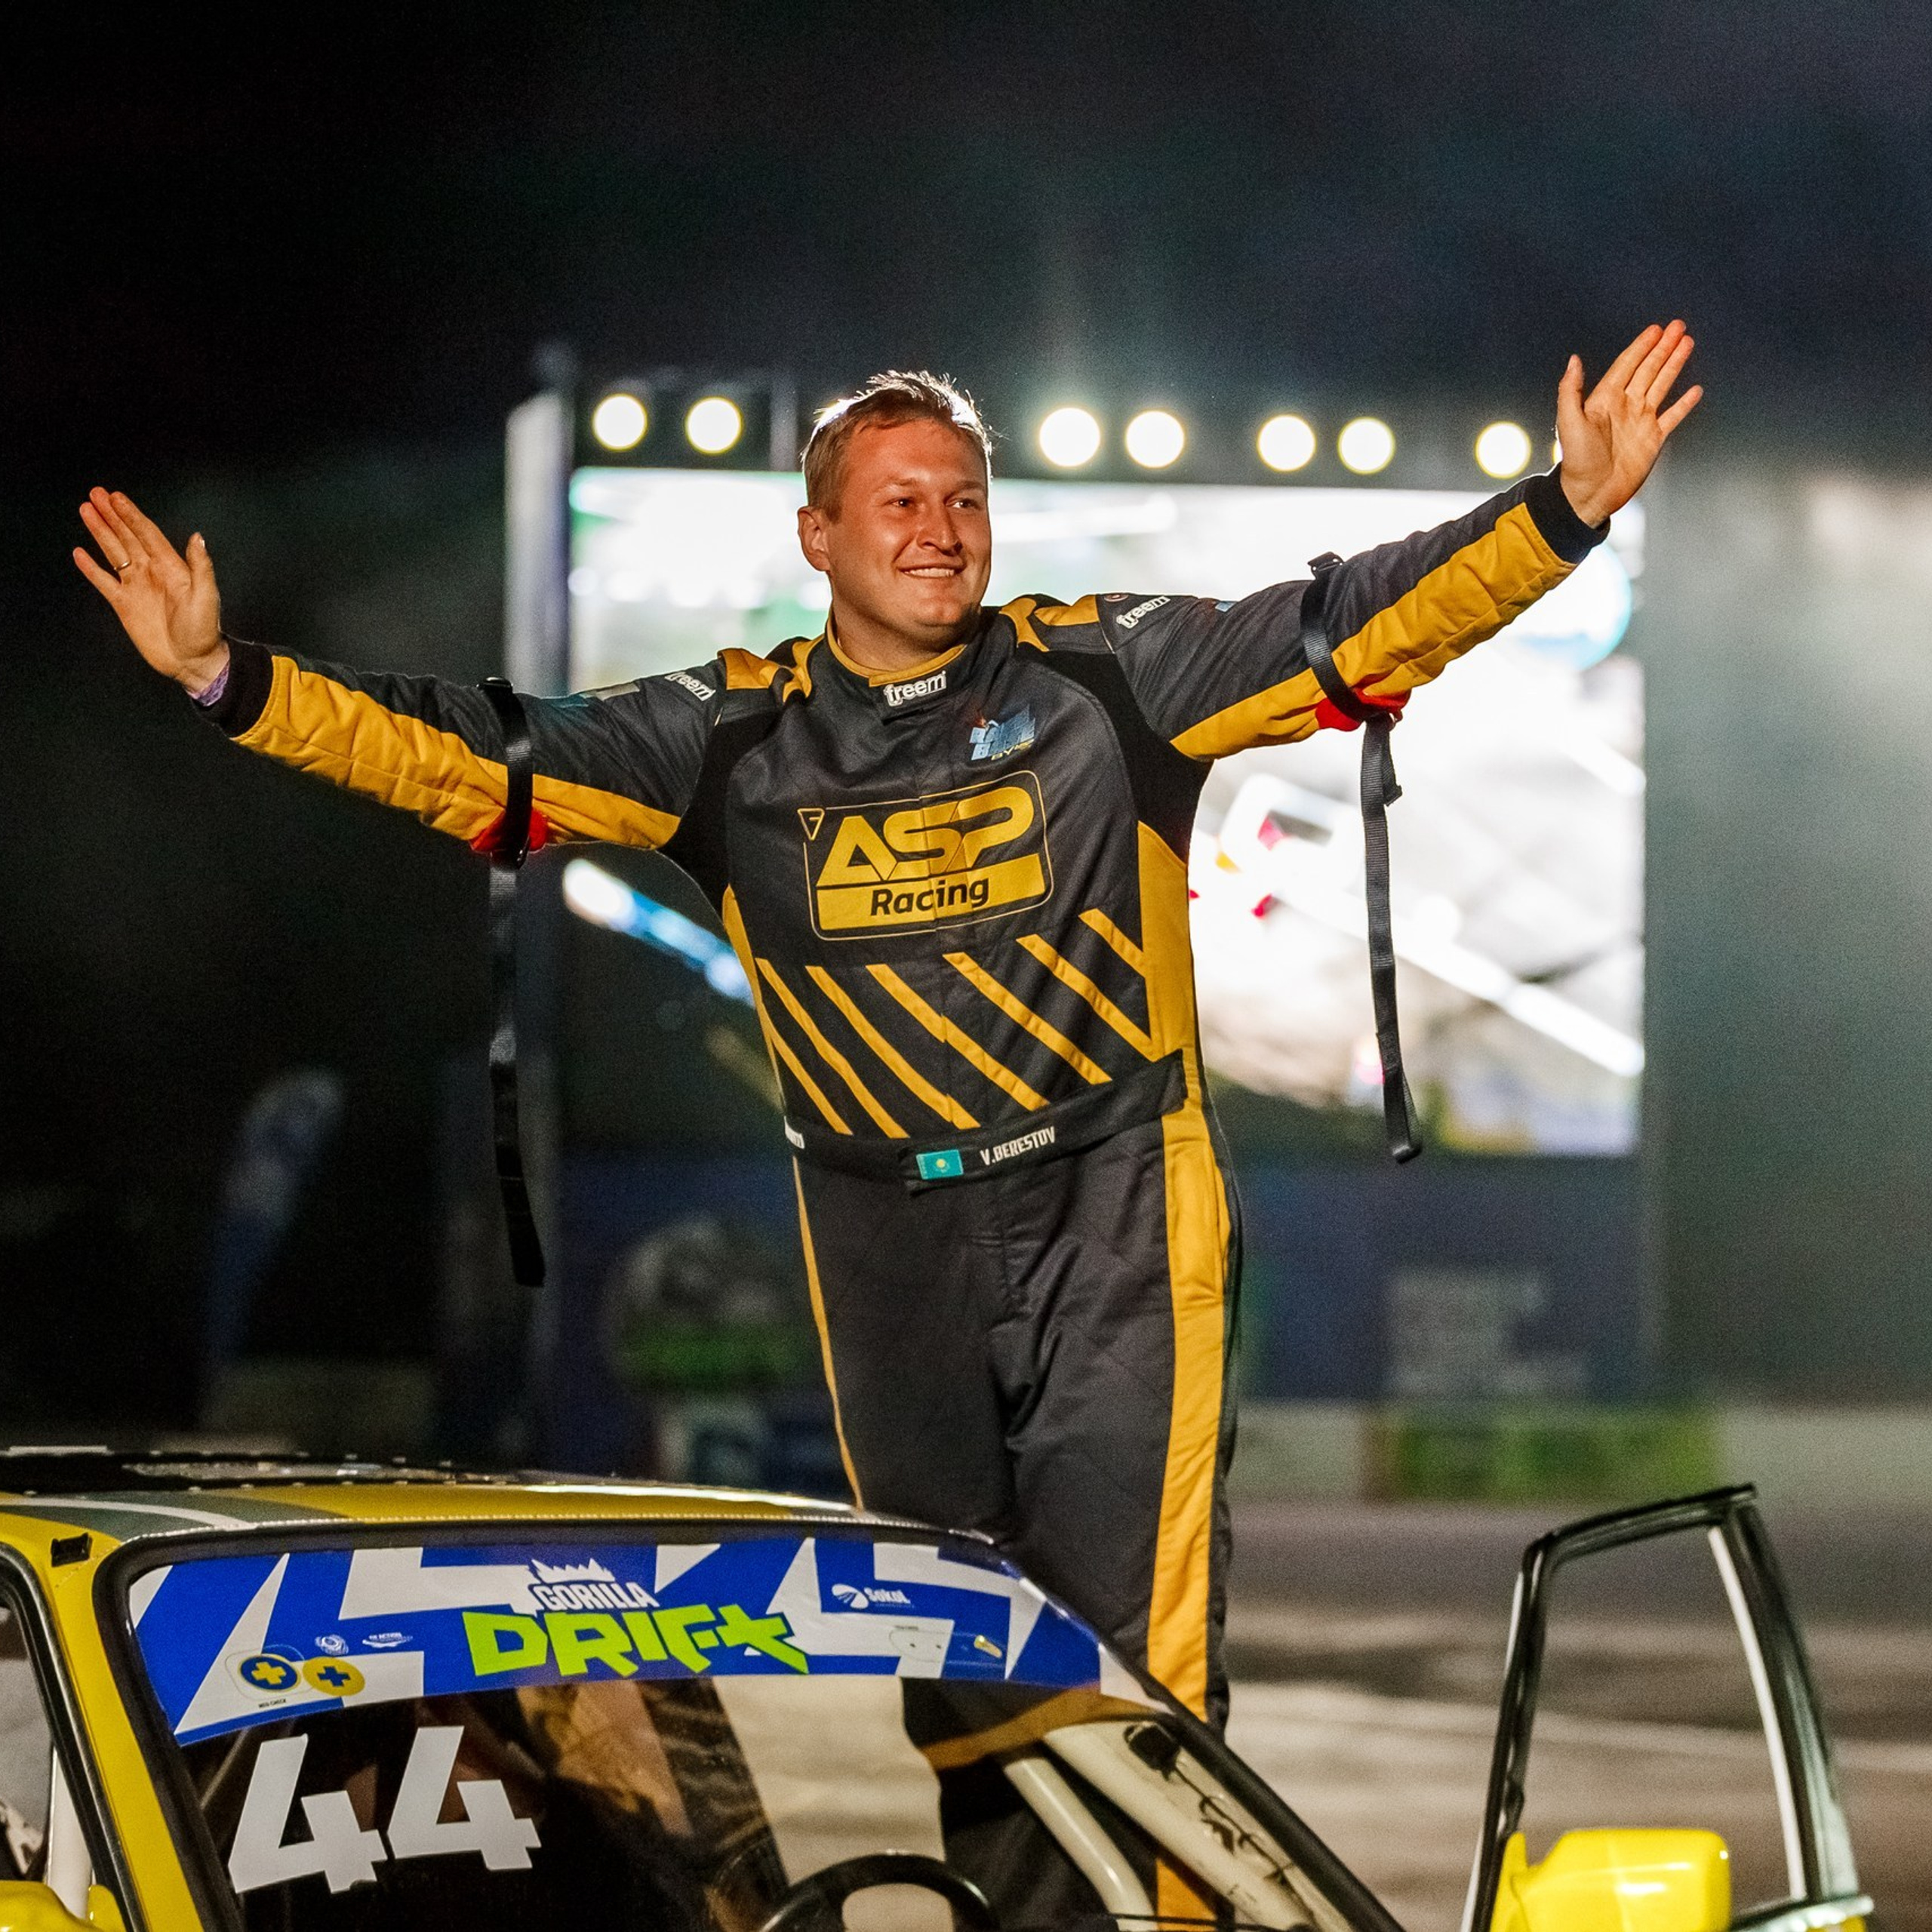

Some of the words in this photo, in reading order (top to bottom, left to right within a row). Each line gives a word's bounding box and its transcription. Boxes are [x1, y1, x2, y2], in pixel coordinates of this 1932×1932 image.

[1116, 595, 1171, 629] freem
[883, 670, 946, 706] freem
[816, 786, 1035, 888] ASP
[870, 878, 989, 916] Racing
[980, 1126, 1057, 1166] V.BERESTOV
[533, 1582, 660, 1611] GORILLA
[227, 1725, 542, 1894] 44
